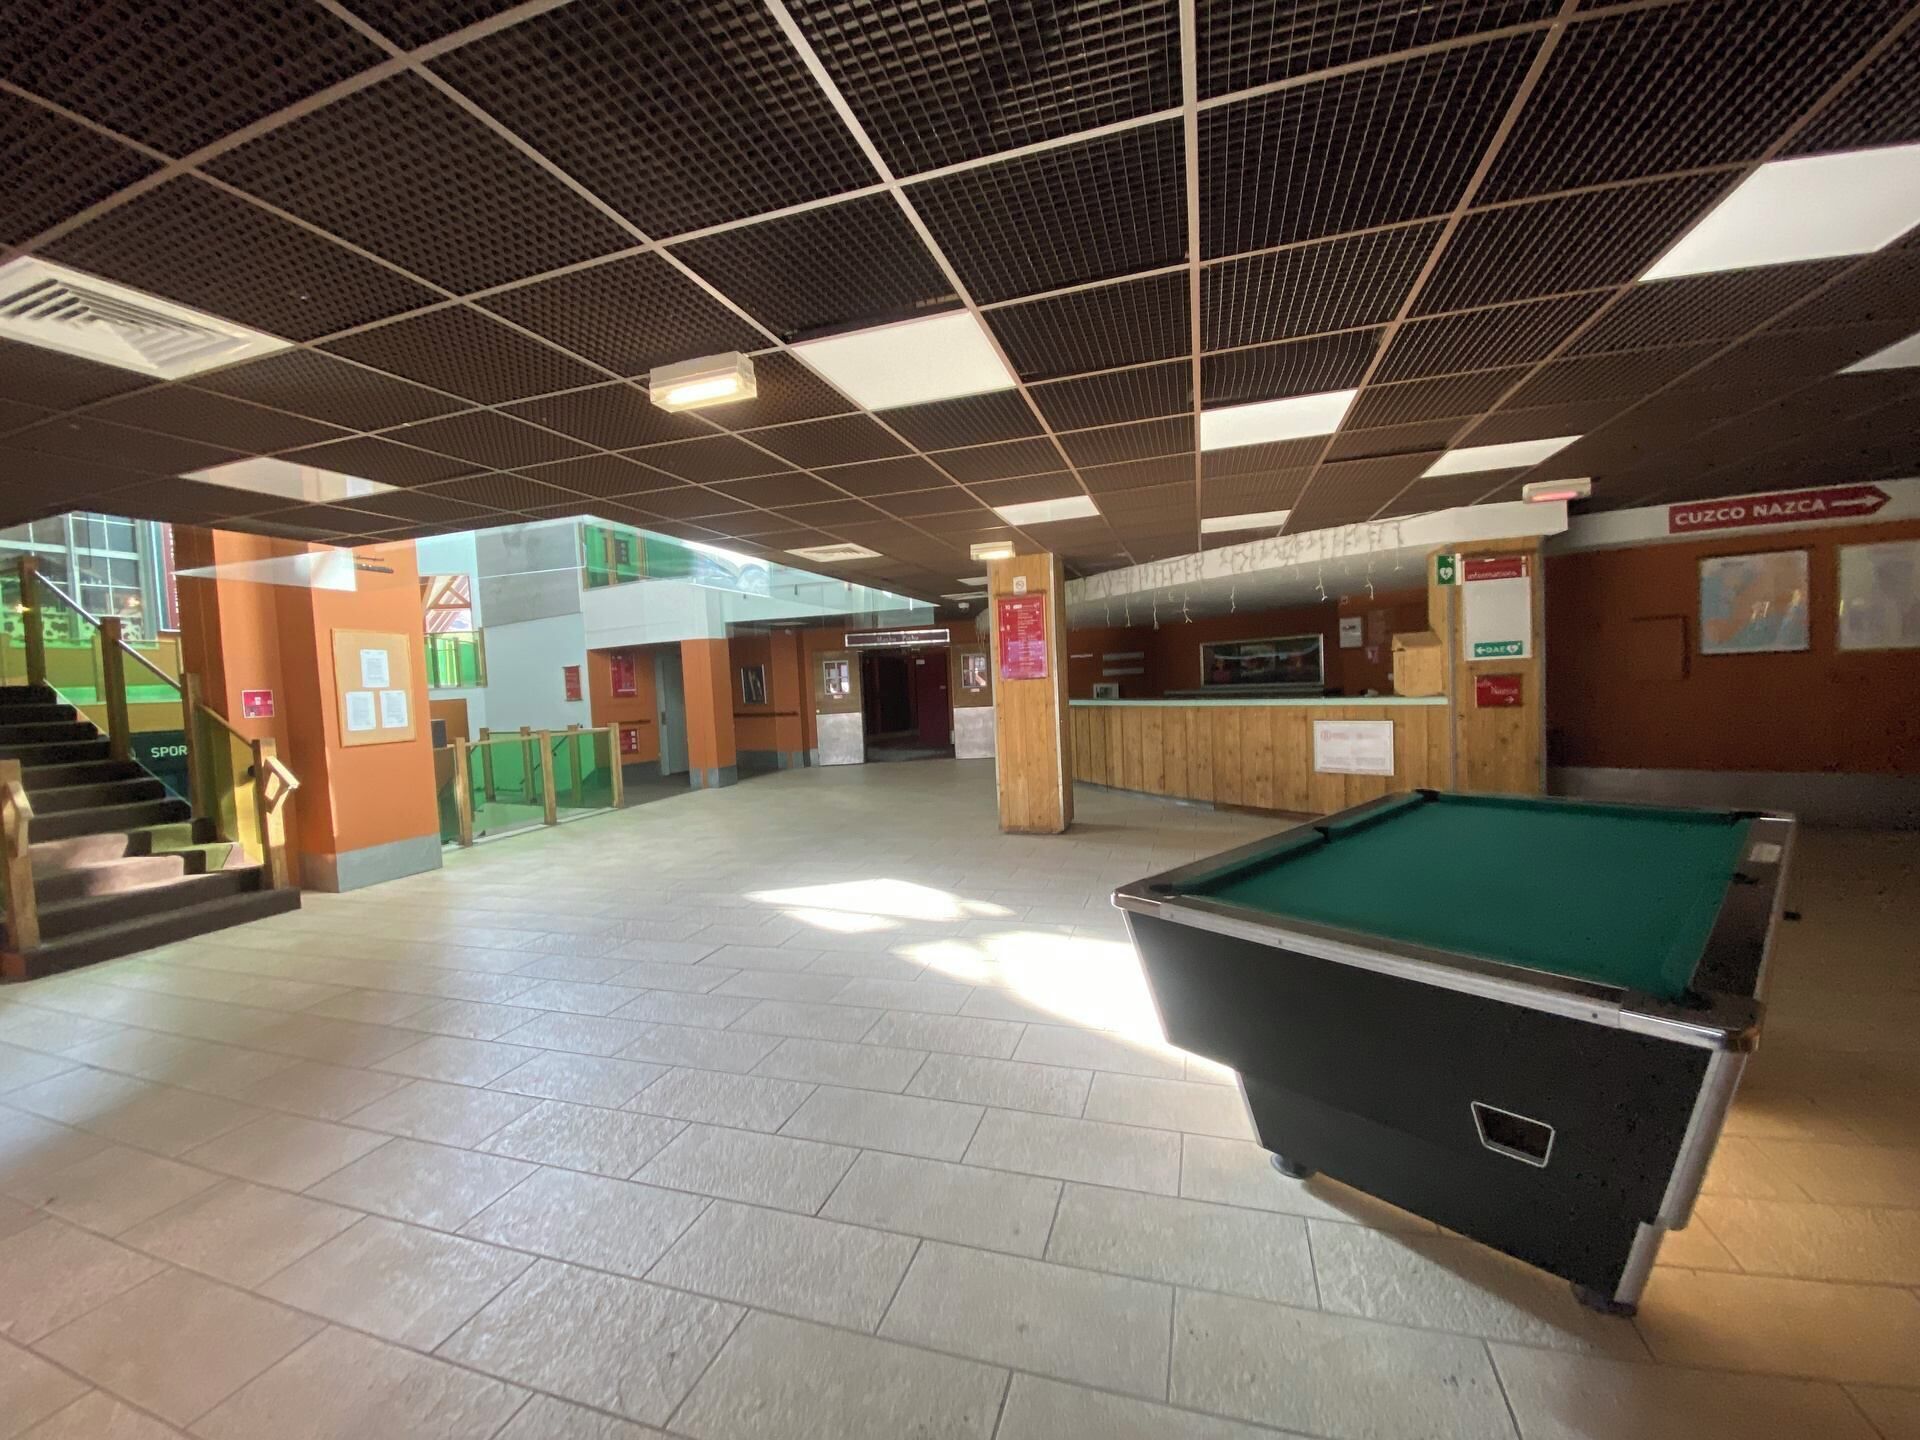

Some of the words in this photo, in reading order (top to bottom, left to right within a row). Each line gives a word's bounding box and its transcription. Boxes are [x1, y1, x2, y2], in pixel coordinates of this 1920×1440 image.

[1674, 506, 1746, 526] CUZCO
[1752, 498, 1827, 518] NAZCA
[150, 744, 188, 759] SPOR
